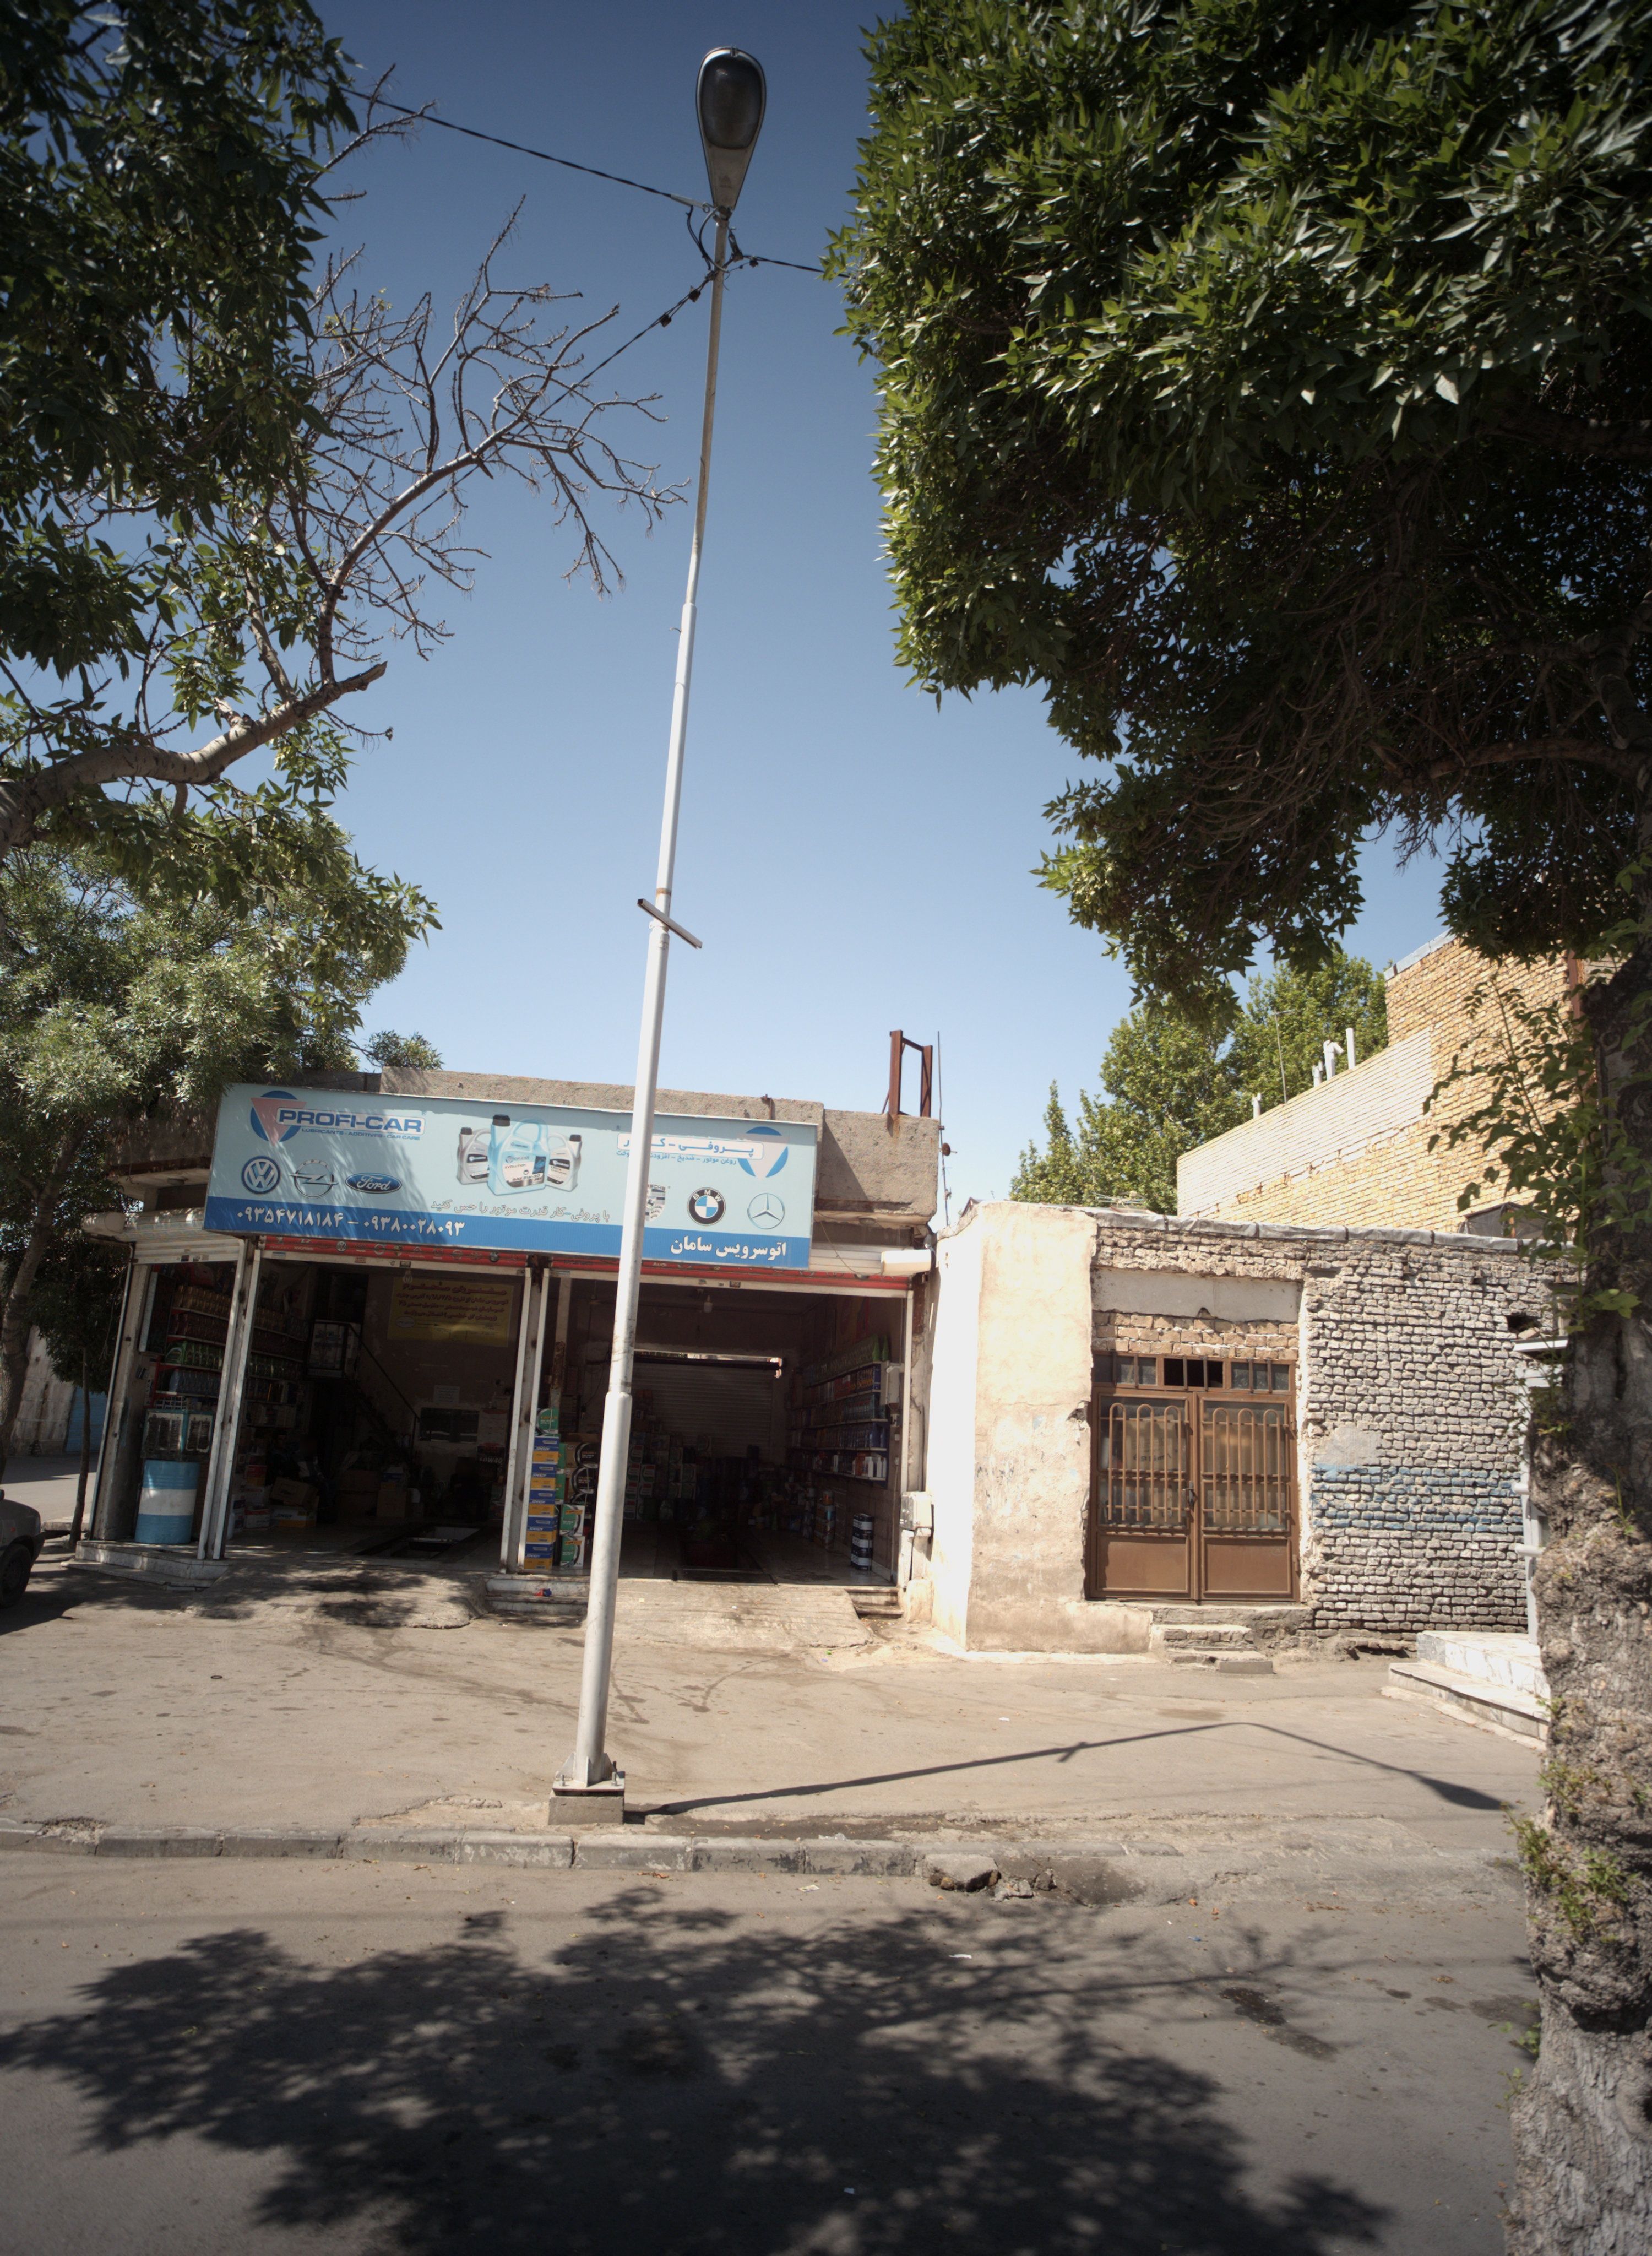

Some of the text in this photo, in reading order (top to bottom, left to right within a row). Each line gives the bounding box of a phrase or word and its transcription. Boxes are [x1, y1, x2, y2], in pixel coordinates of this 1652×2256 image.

[279, 1110, 422, 1133] PROFI-CAR
[623, 1138, 666, 1147] کر
[678, 1141, 754, 1157] پروفی
[356, 1174, 391, 1191] Ford
[692, 1189, 722, 1203] BMW
[431, 1199, 454, 1211] کنید
[454, 1202, 477, 1213] حس
[479, 1201, 488, 1213] را
[490, 1203, 517, 1216] موتور
[519, 1205, 548, 1217] قدرت
[237, 1206, 344, 1228] ۰۹۳۵۴۷۱۸۱۸۴
[363, 1215, 466, 1237] ۰۹۳۸۰۰۲۸۰۹۳
[602, 1209, 610, 1223] با
[670, 1235, 713, 1254] سامان
